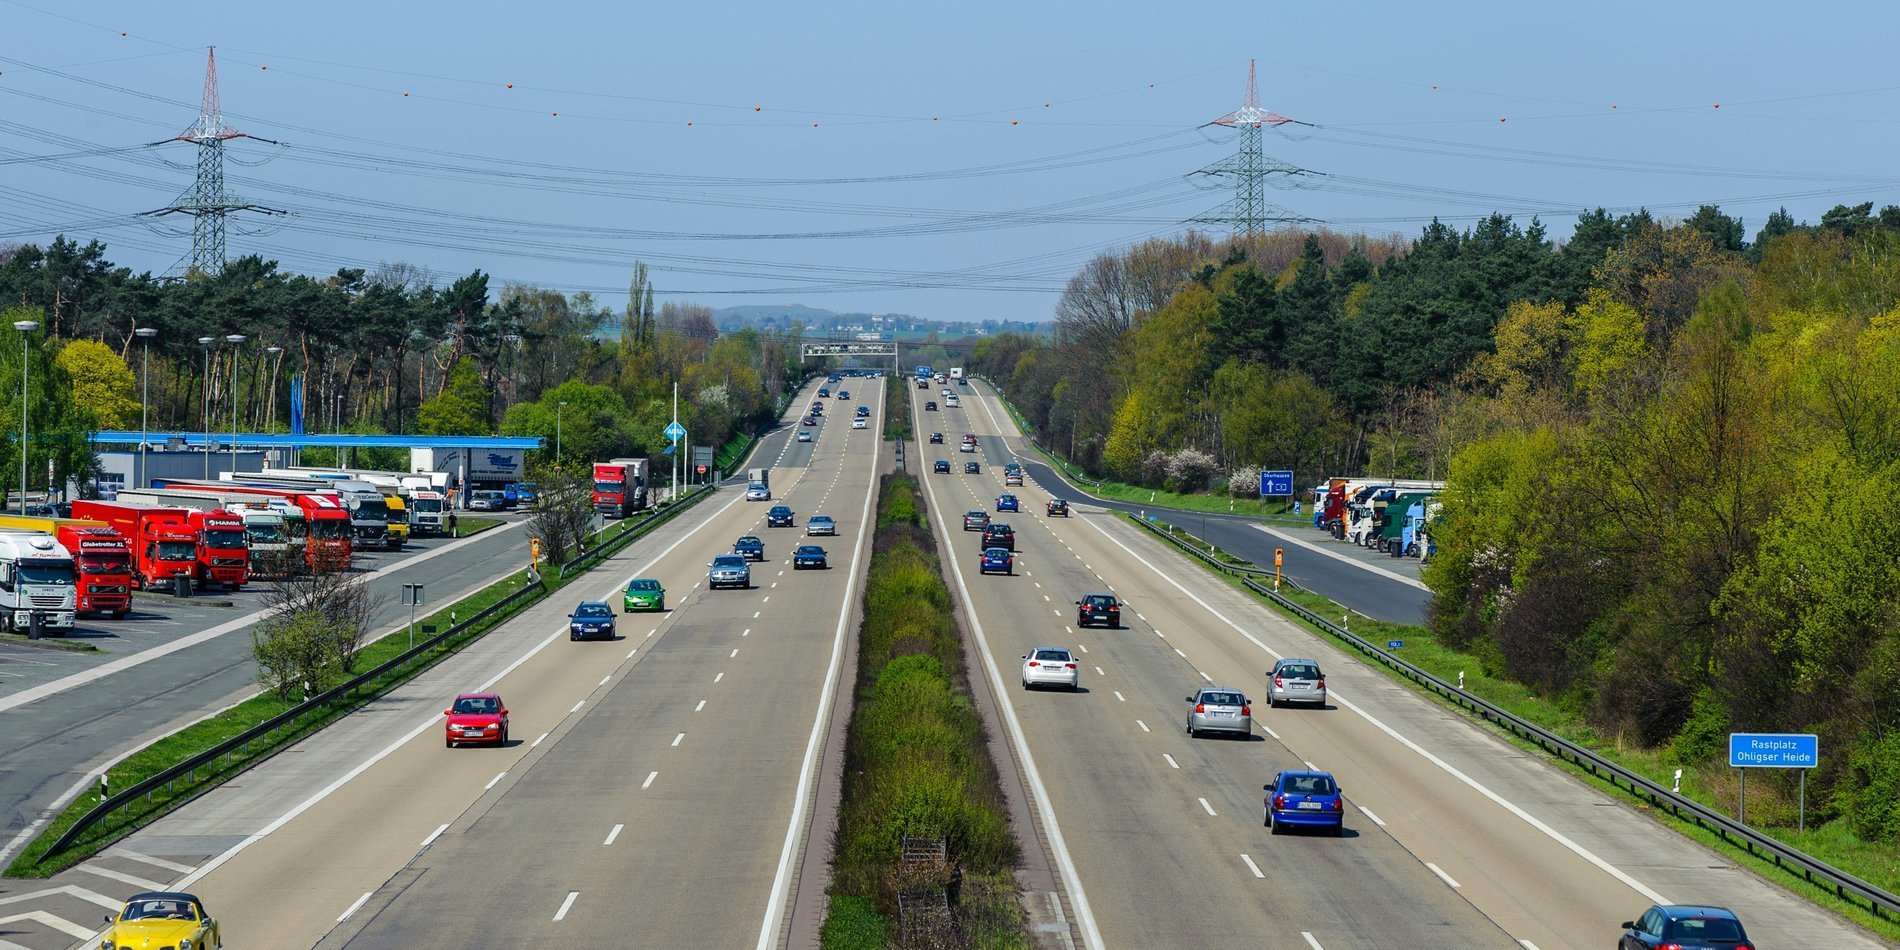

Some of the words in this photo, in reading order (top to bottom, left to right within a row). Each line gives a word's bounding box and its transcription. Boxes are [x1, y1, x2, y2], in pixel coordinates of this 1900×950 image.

[1751, 739, 1797, 751] Rastplatz
[1737, 751, 1778, 763] Ohligser
[1783, 752, 1811, 762] Heide
